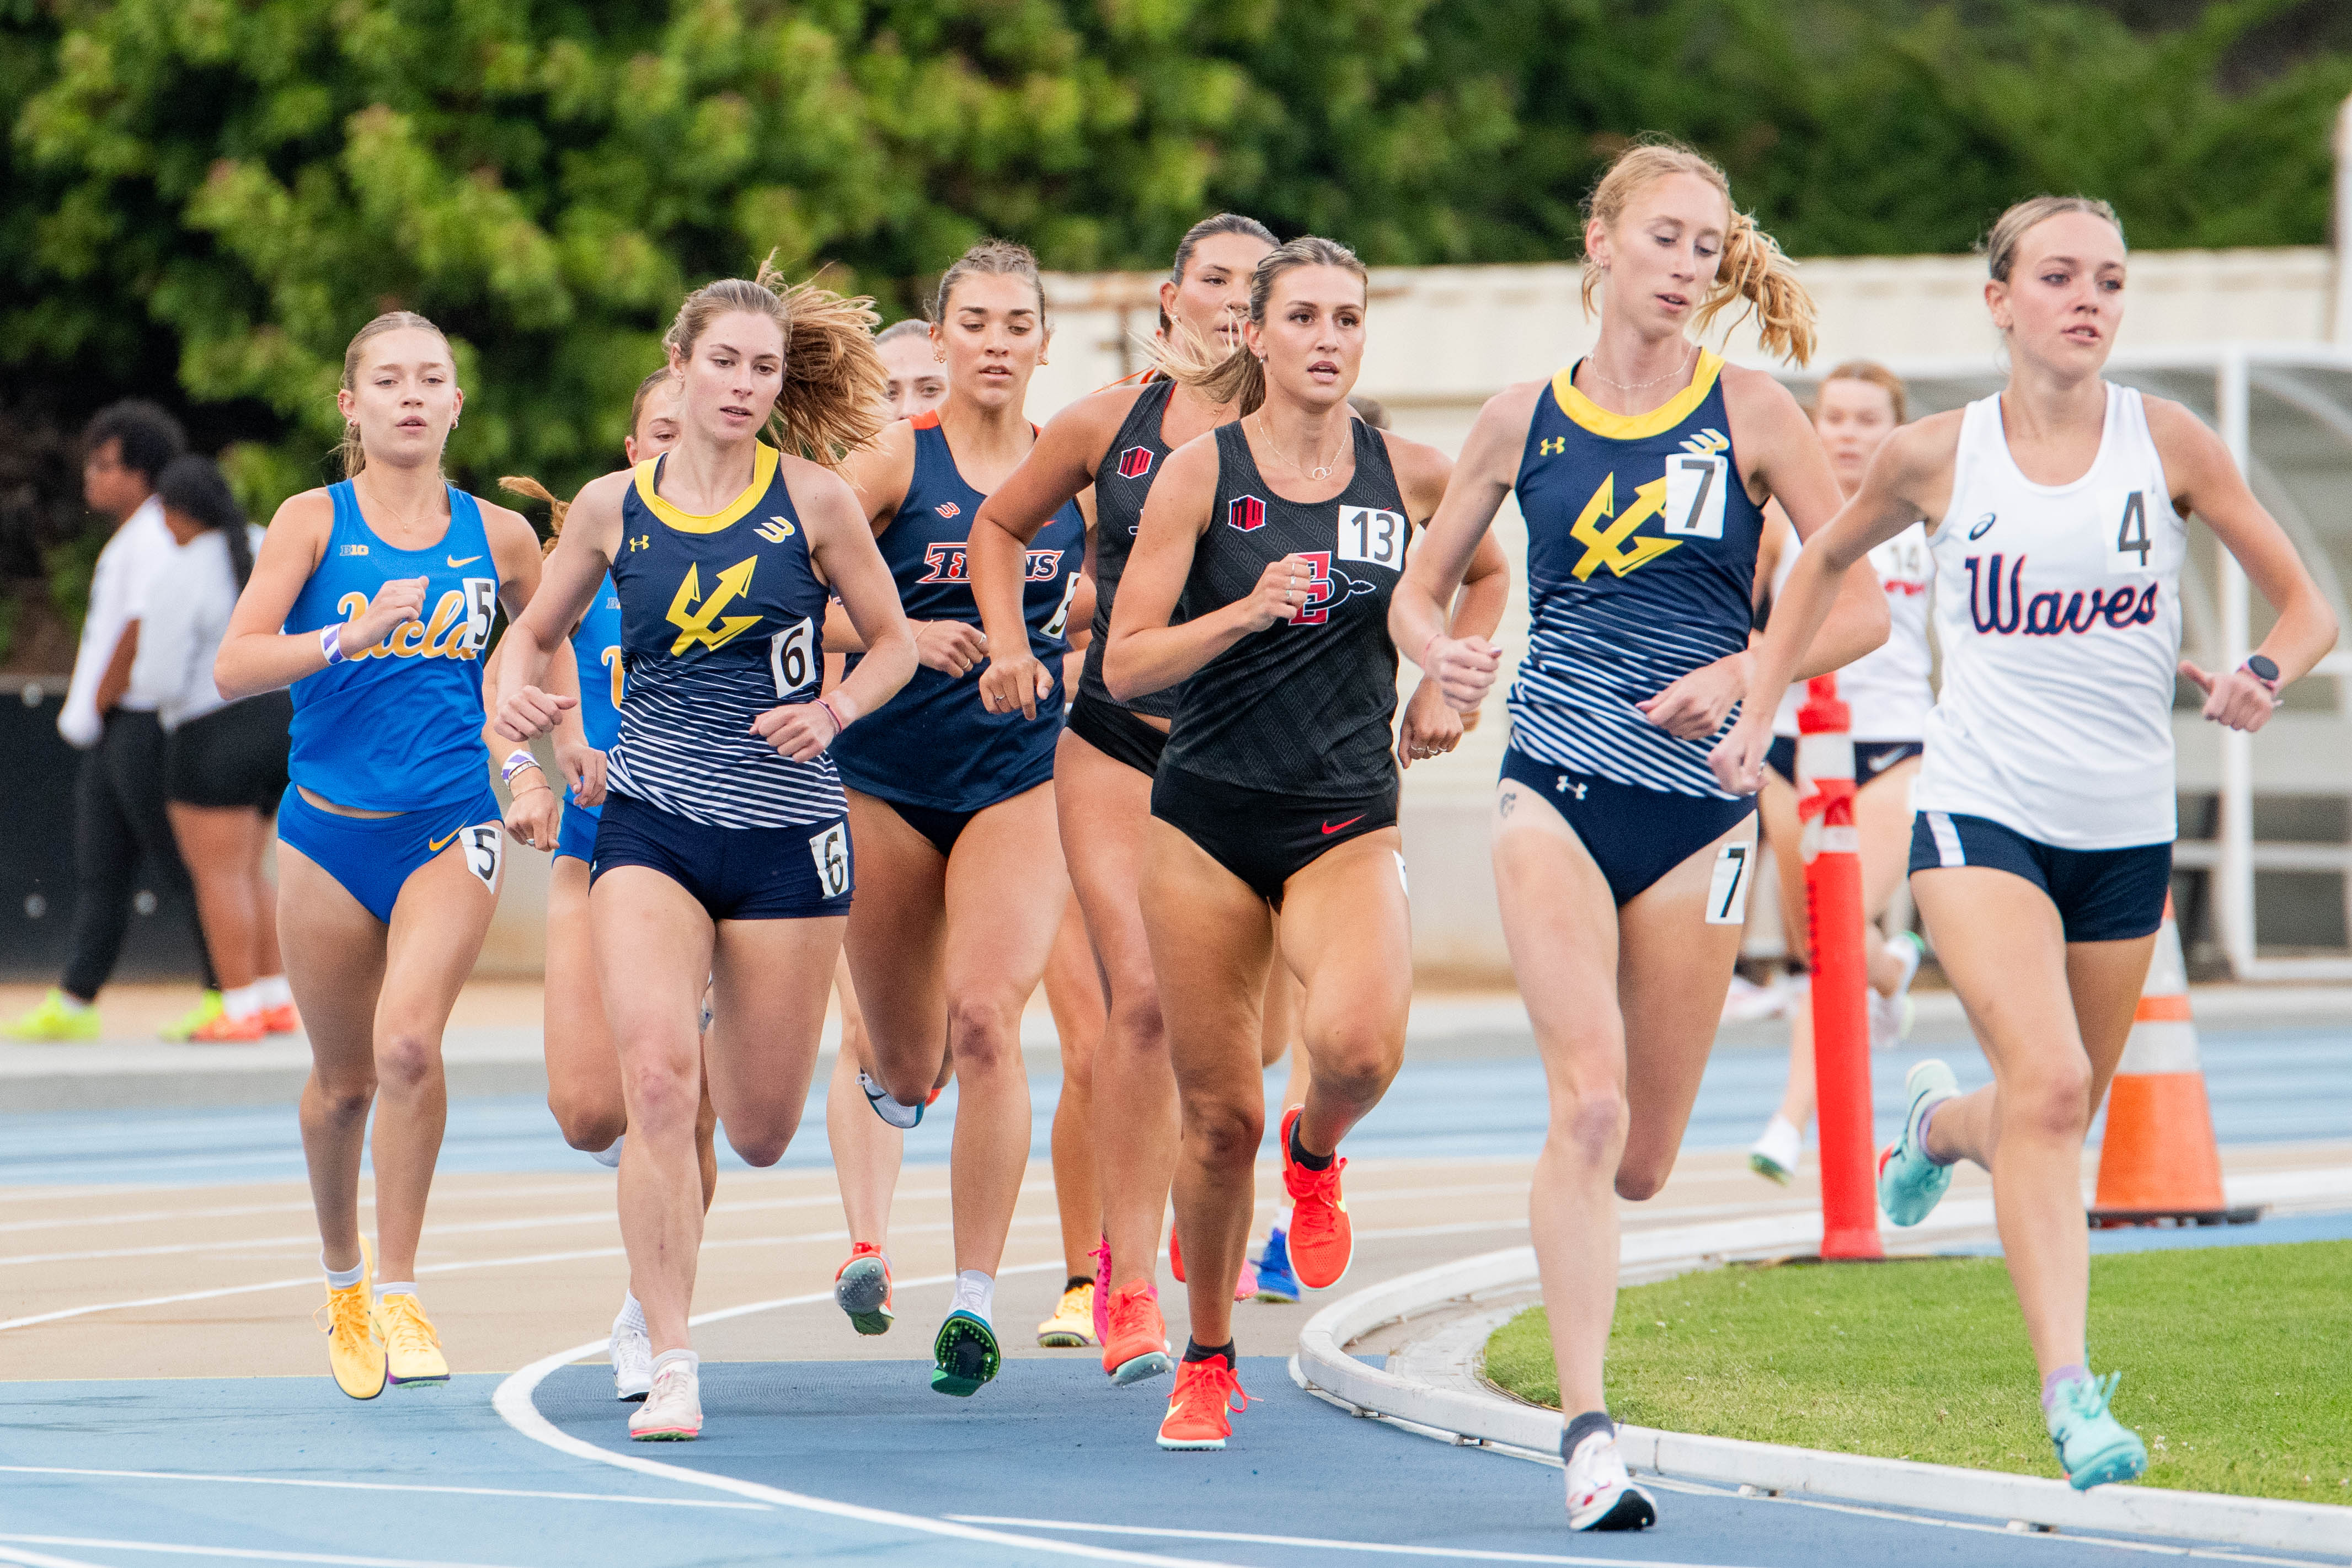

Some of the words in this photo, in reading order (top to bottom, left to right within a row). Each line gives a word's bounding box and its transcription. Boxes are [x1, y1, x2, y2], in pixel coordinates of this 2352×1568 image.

[1681, 459, 1715, 529] 7
[1351, 511, 1395, 563] 13
[2118, 490, 2151, 566] 4
[474, 582, 492, 646] 5
[1965, 553, 2158, 636] Waves
[781, 627, 806, 687] 6
[473, 828, 495, 881] 5
[824, 831, 844, 895] 6
[1719, 848, 1746, 918] 7
